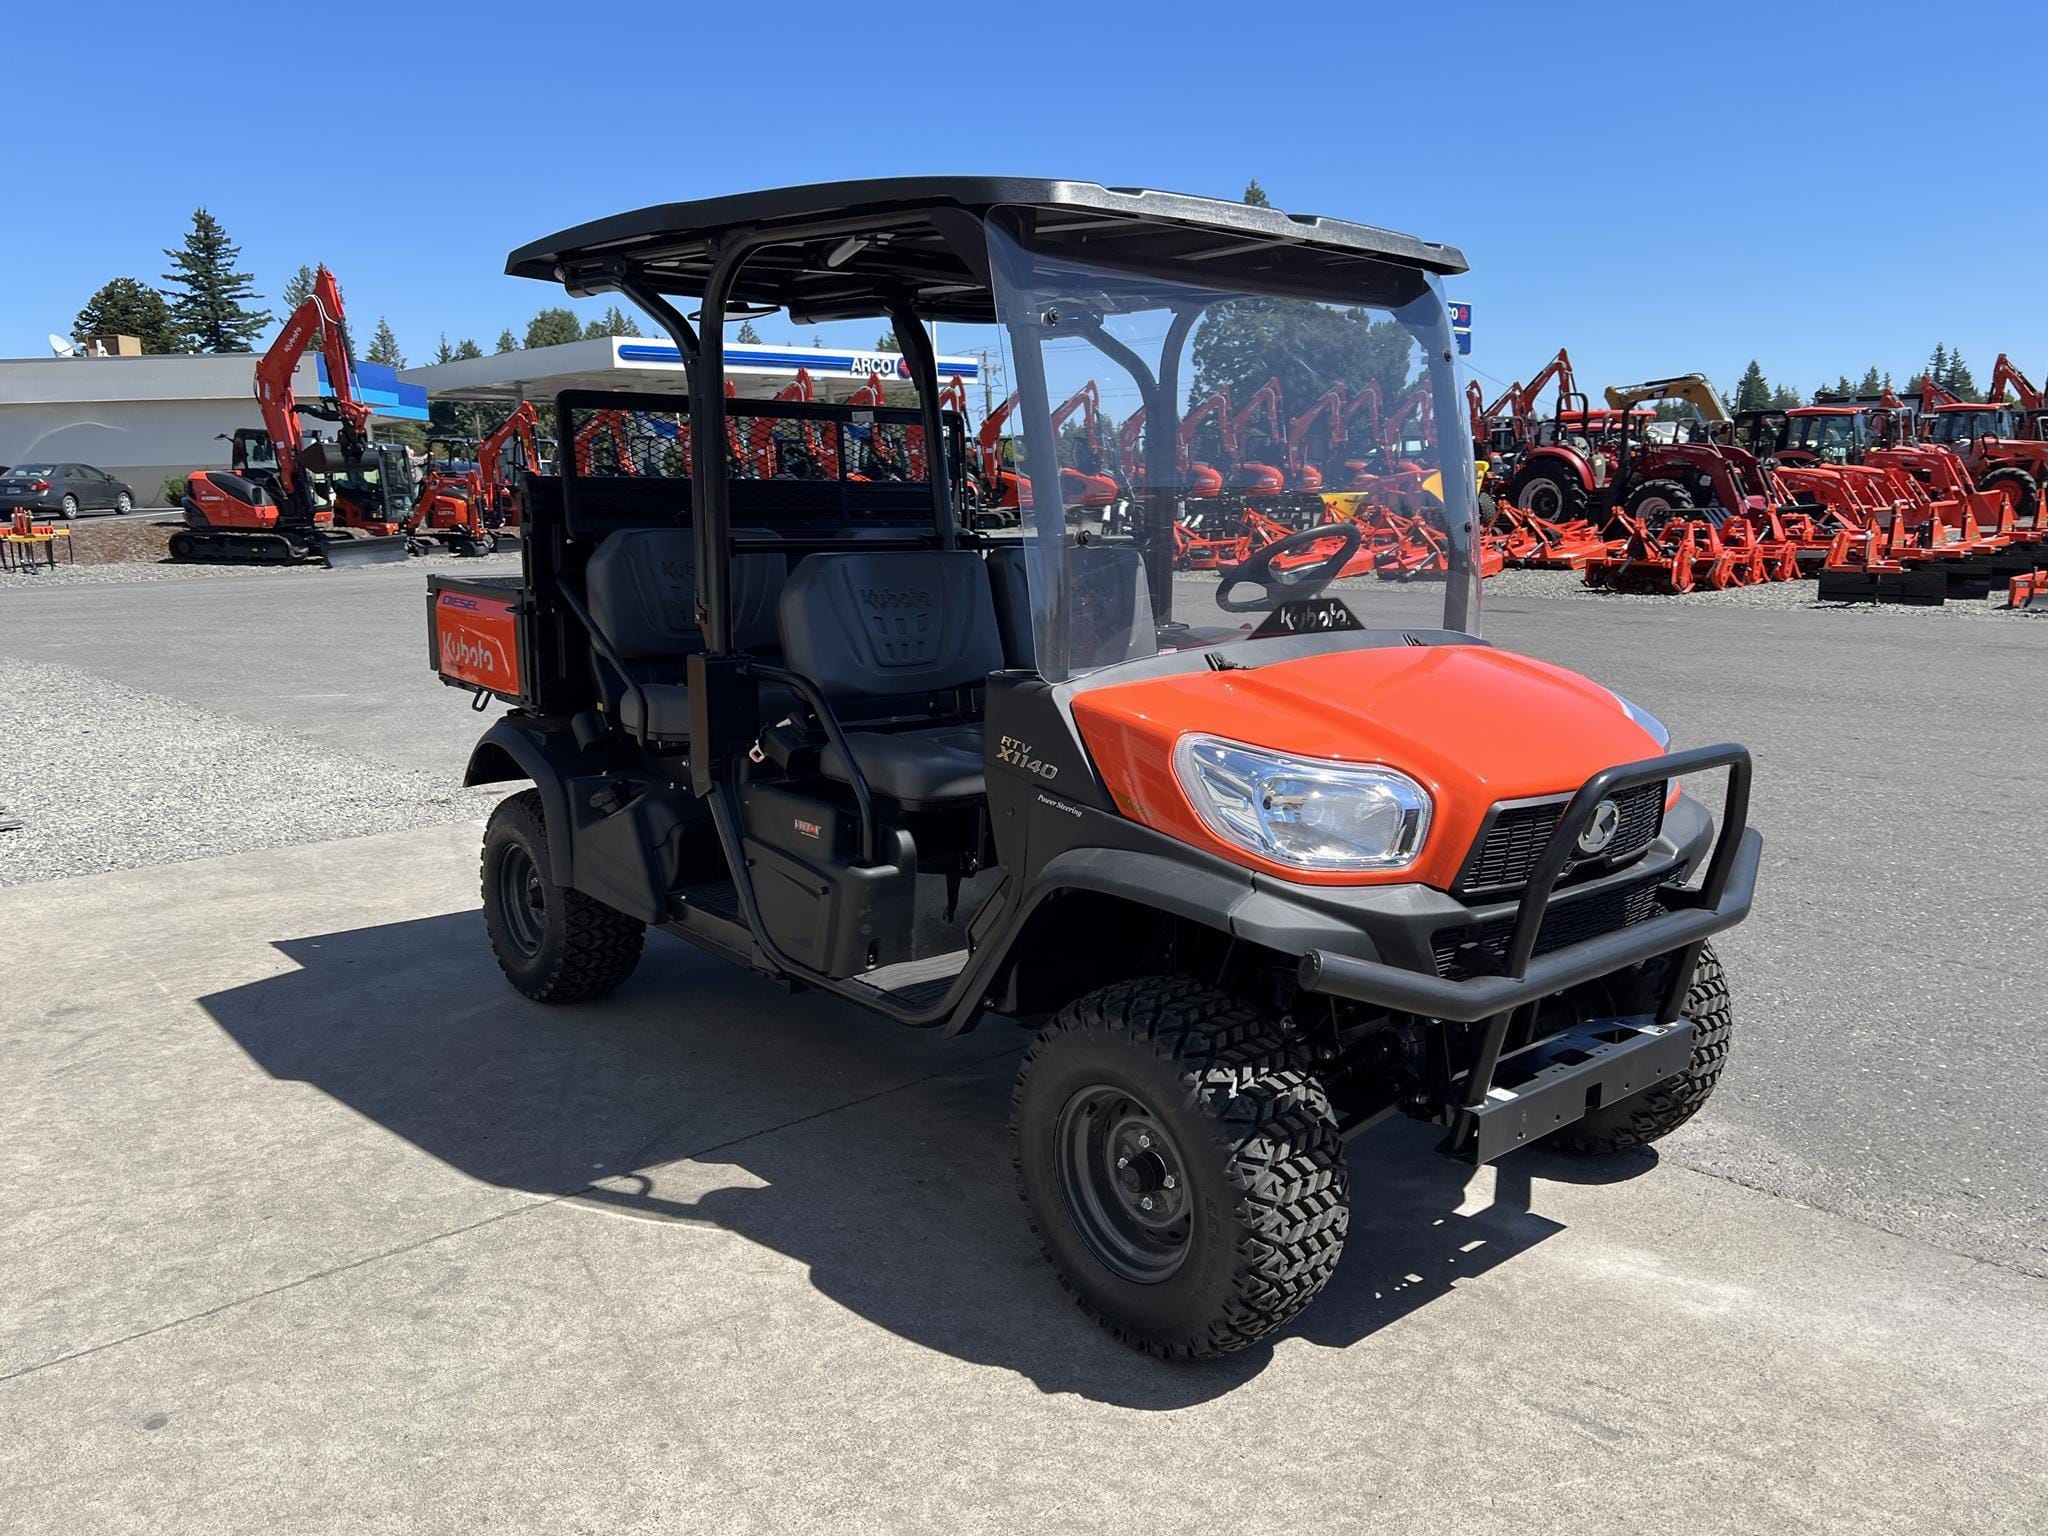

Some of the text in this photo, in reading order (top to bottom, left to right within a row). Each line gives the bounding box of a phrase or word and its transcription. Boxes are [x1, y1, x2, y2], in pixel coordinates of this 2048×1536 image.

[283, 326, 302, 353] Kubota
[851, 357, 892, 374] ARCO
[442, 595, 480, 611] DIESEL
[860, 587, 934, 609] Kubota
[442, 631, 494, 672] Kubota
[1000, 735, 1032, 754] RTV
[995, 745, 1058, 780] X1140
[1037, 794, 1083, 818] Power Steering
